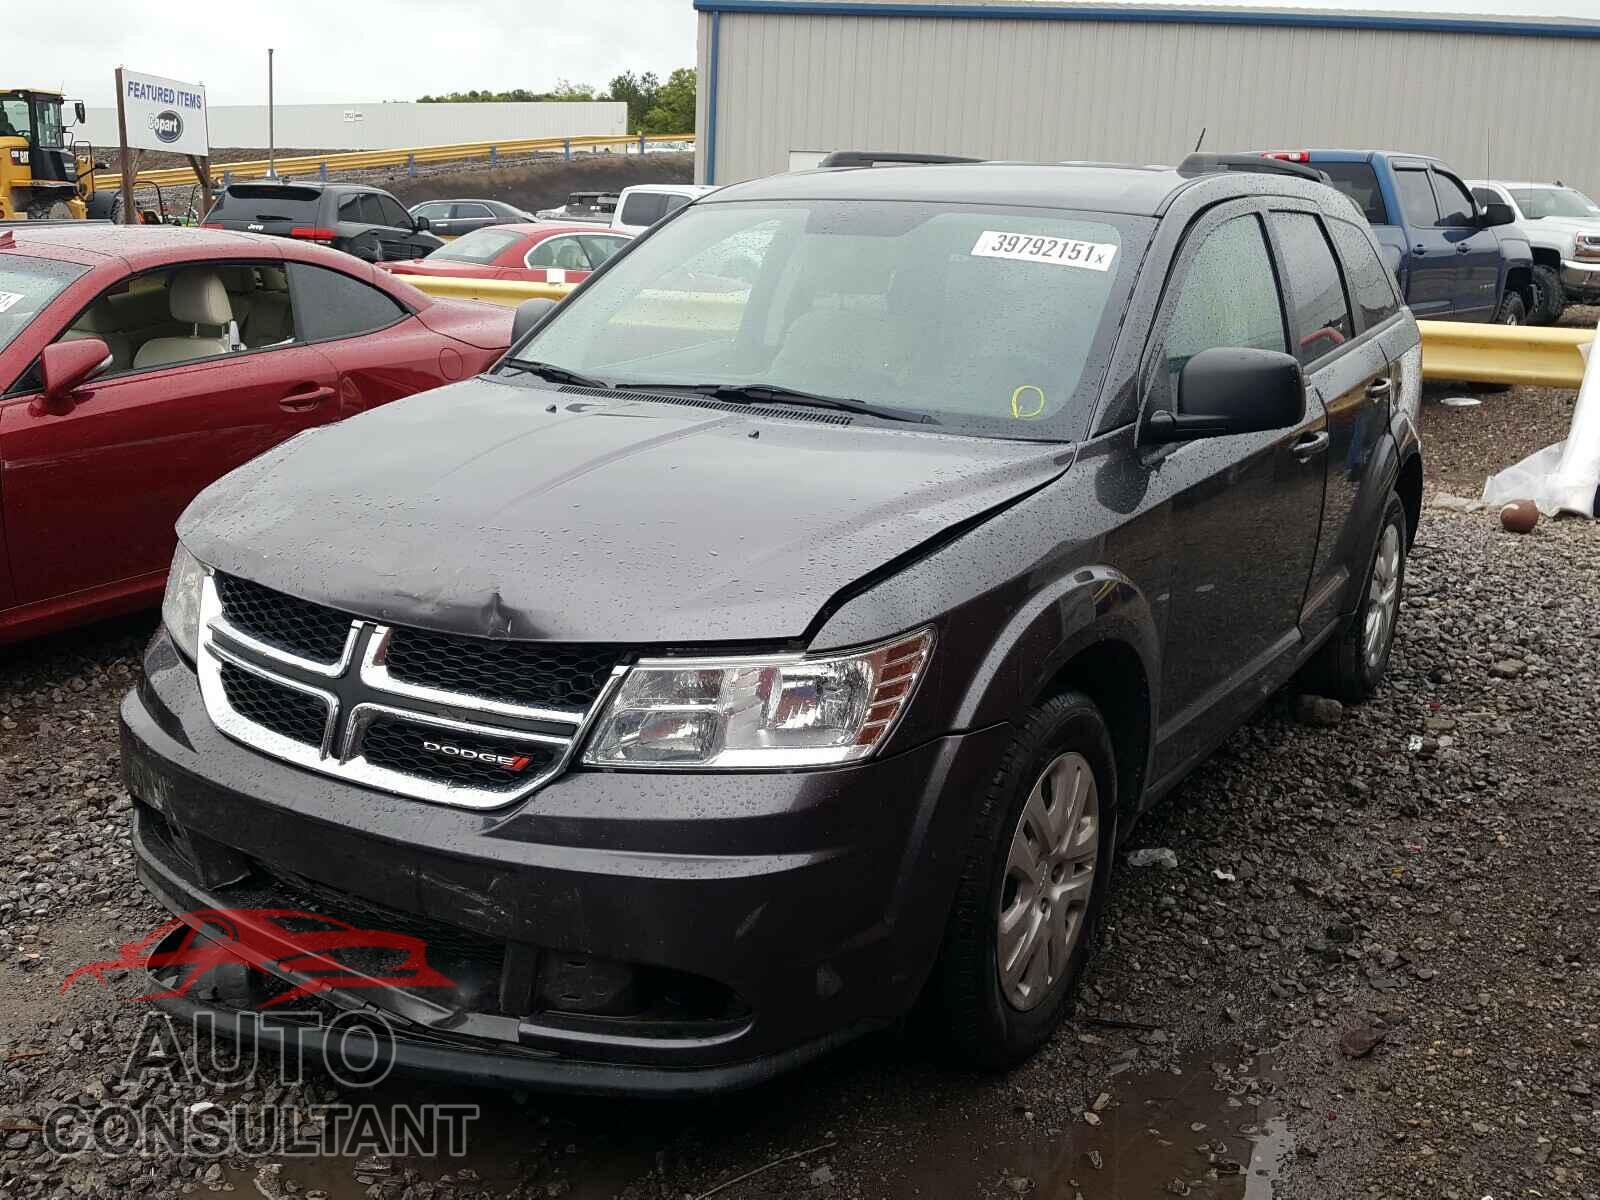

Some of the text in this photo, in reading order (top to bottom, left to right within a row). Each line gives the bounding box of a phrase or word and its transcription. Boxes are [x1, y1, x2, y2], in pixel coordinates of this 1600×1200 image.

[128, 81, 201, 108] FEATURED ITEMS
[148, 113, 177, 133] Copart
[248, 223, 264, 231] Jeep
[424, 741, 514, 766] DODGE
